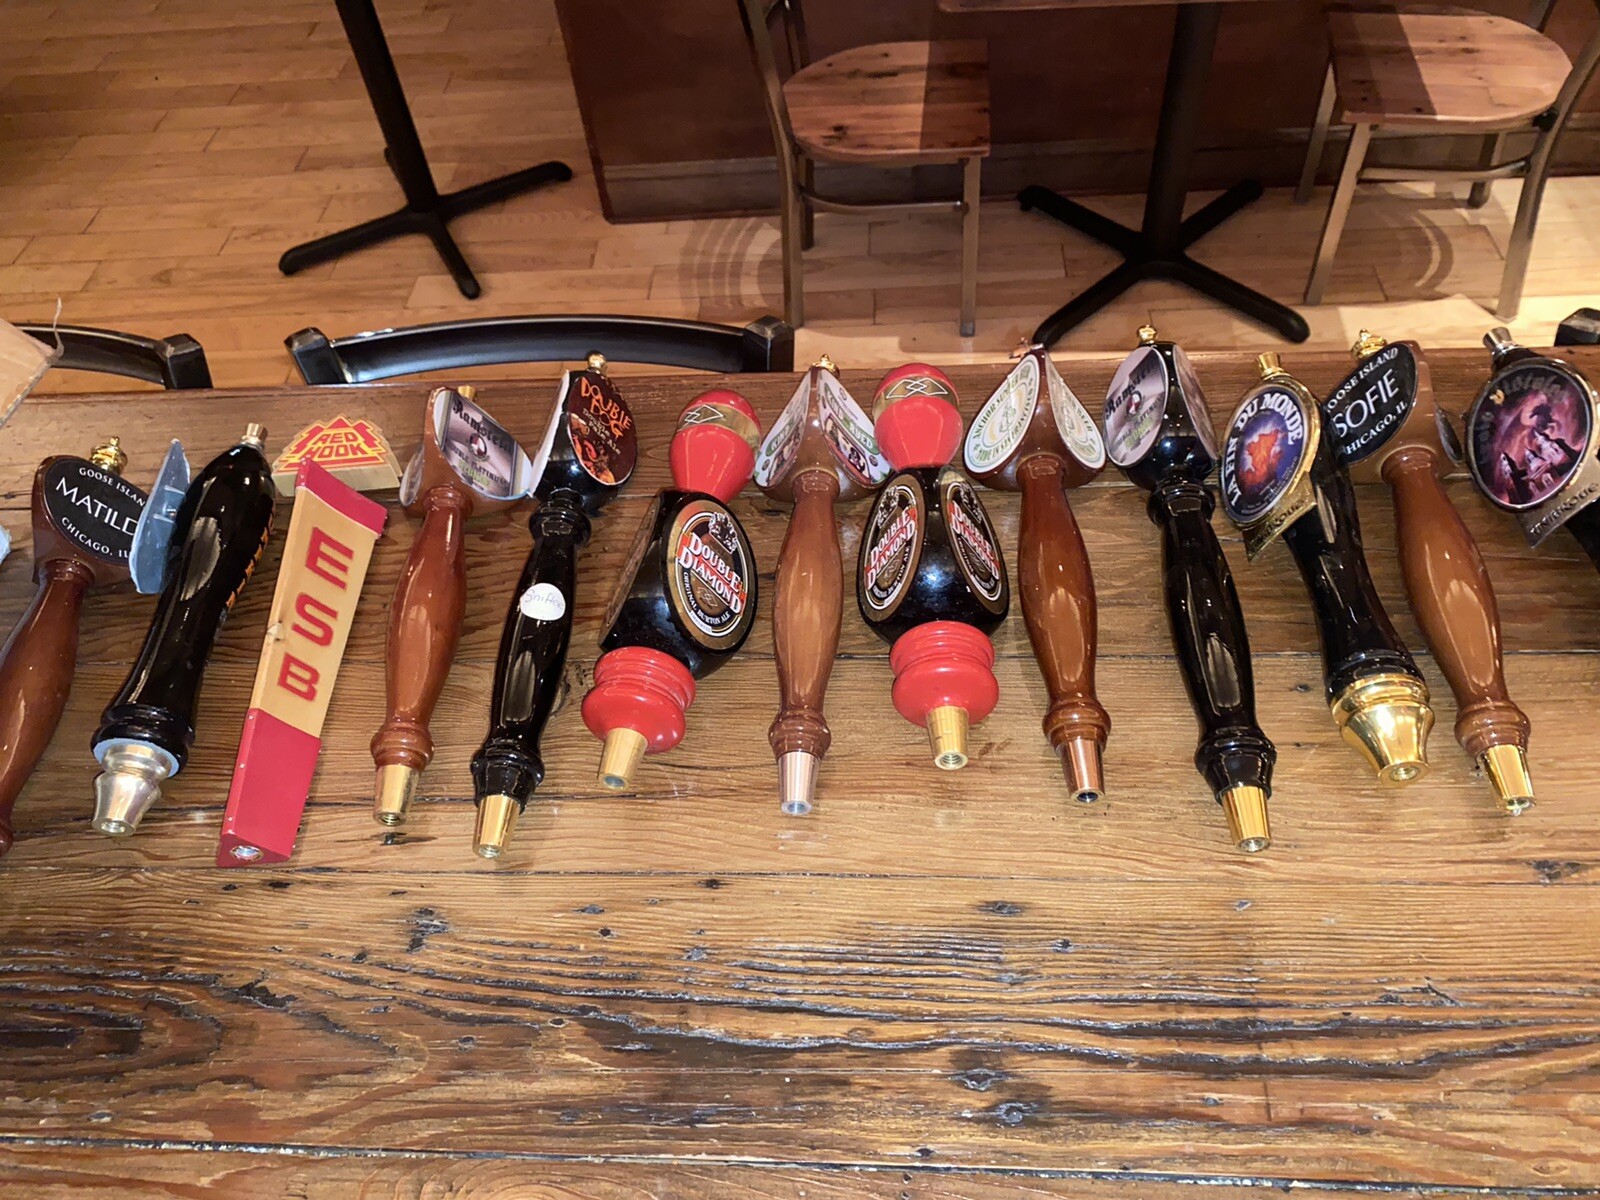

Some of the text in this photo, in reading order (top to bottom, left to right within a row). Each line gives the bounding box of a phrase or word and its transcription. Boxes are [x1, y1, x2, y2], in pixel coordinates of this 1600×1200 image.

[581, 377, 632, 430] DOUBLE
[1326, 347, 1399, 413] OOSE ISLAND
[1333, 369, 1399, 438] SOFIE
[312, 431, 359, 445] RED
[588, 421, 621, 455] Pale Ale
[590, 399, 624, 438] DOG
[1225, 392, 1304, 506] LA FIN DU MONDE
[1344, 401, 1408, 455] HICAGO, IL
[79, 467, 113, 486] GOOSE
[301, 444, 369, 459] HOOK
[867, 520, 915, 591] DIAMOND
[870, 506, 909, 568] DOUBLE
[951, 500, 994, 560] DOUBLE
[951, 512, 999, 581] DIAMOND
[678, 545, 742, 614] DIAMOND
[688, 532, 742, 593] DOUBLE
[277, 527, 354, 702] ESB
